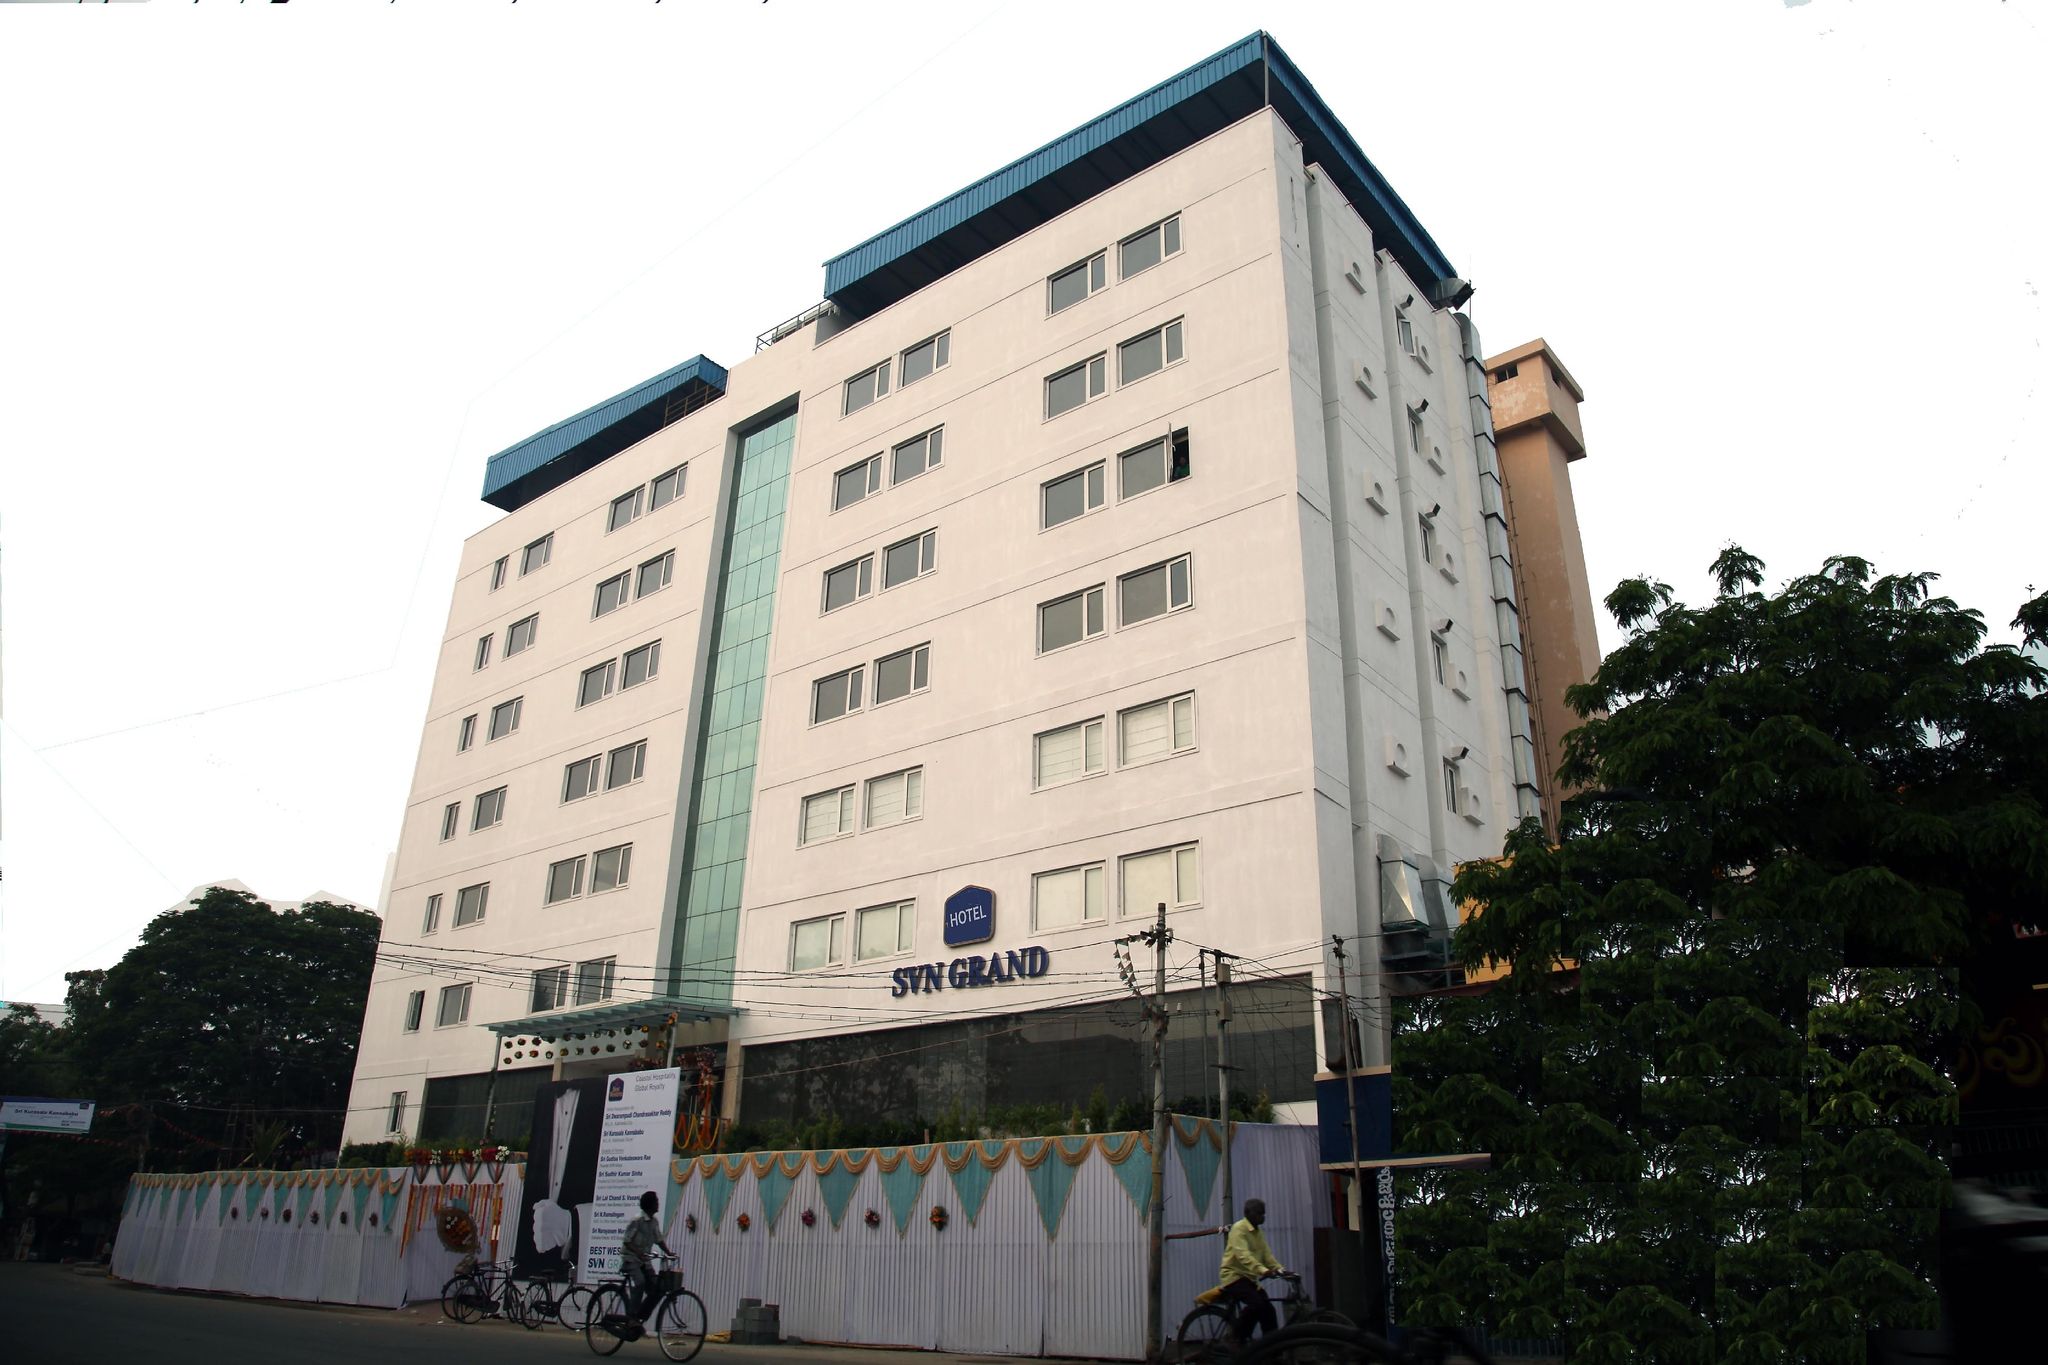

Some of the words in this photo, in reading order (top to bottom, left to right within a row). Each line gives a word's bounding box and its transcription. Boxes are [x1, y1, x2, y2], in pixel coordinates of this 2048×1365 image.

[949, 905, 987, 927] HOTEL
[891, 962, 946, 998] SVN
[948, 946, 1050, 989] GRAND
[589, 1246, 606, 1255] BEST
[587, 1257, 605, 1269] SVN
